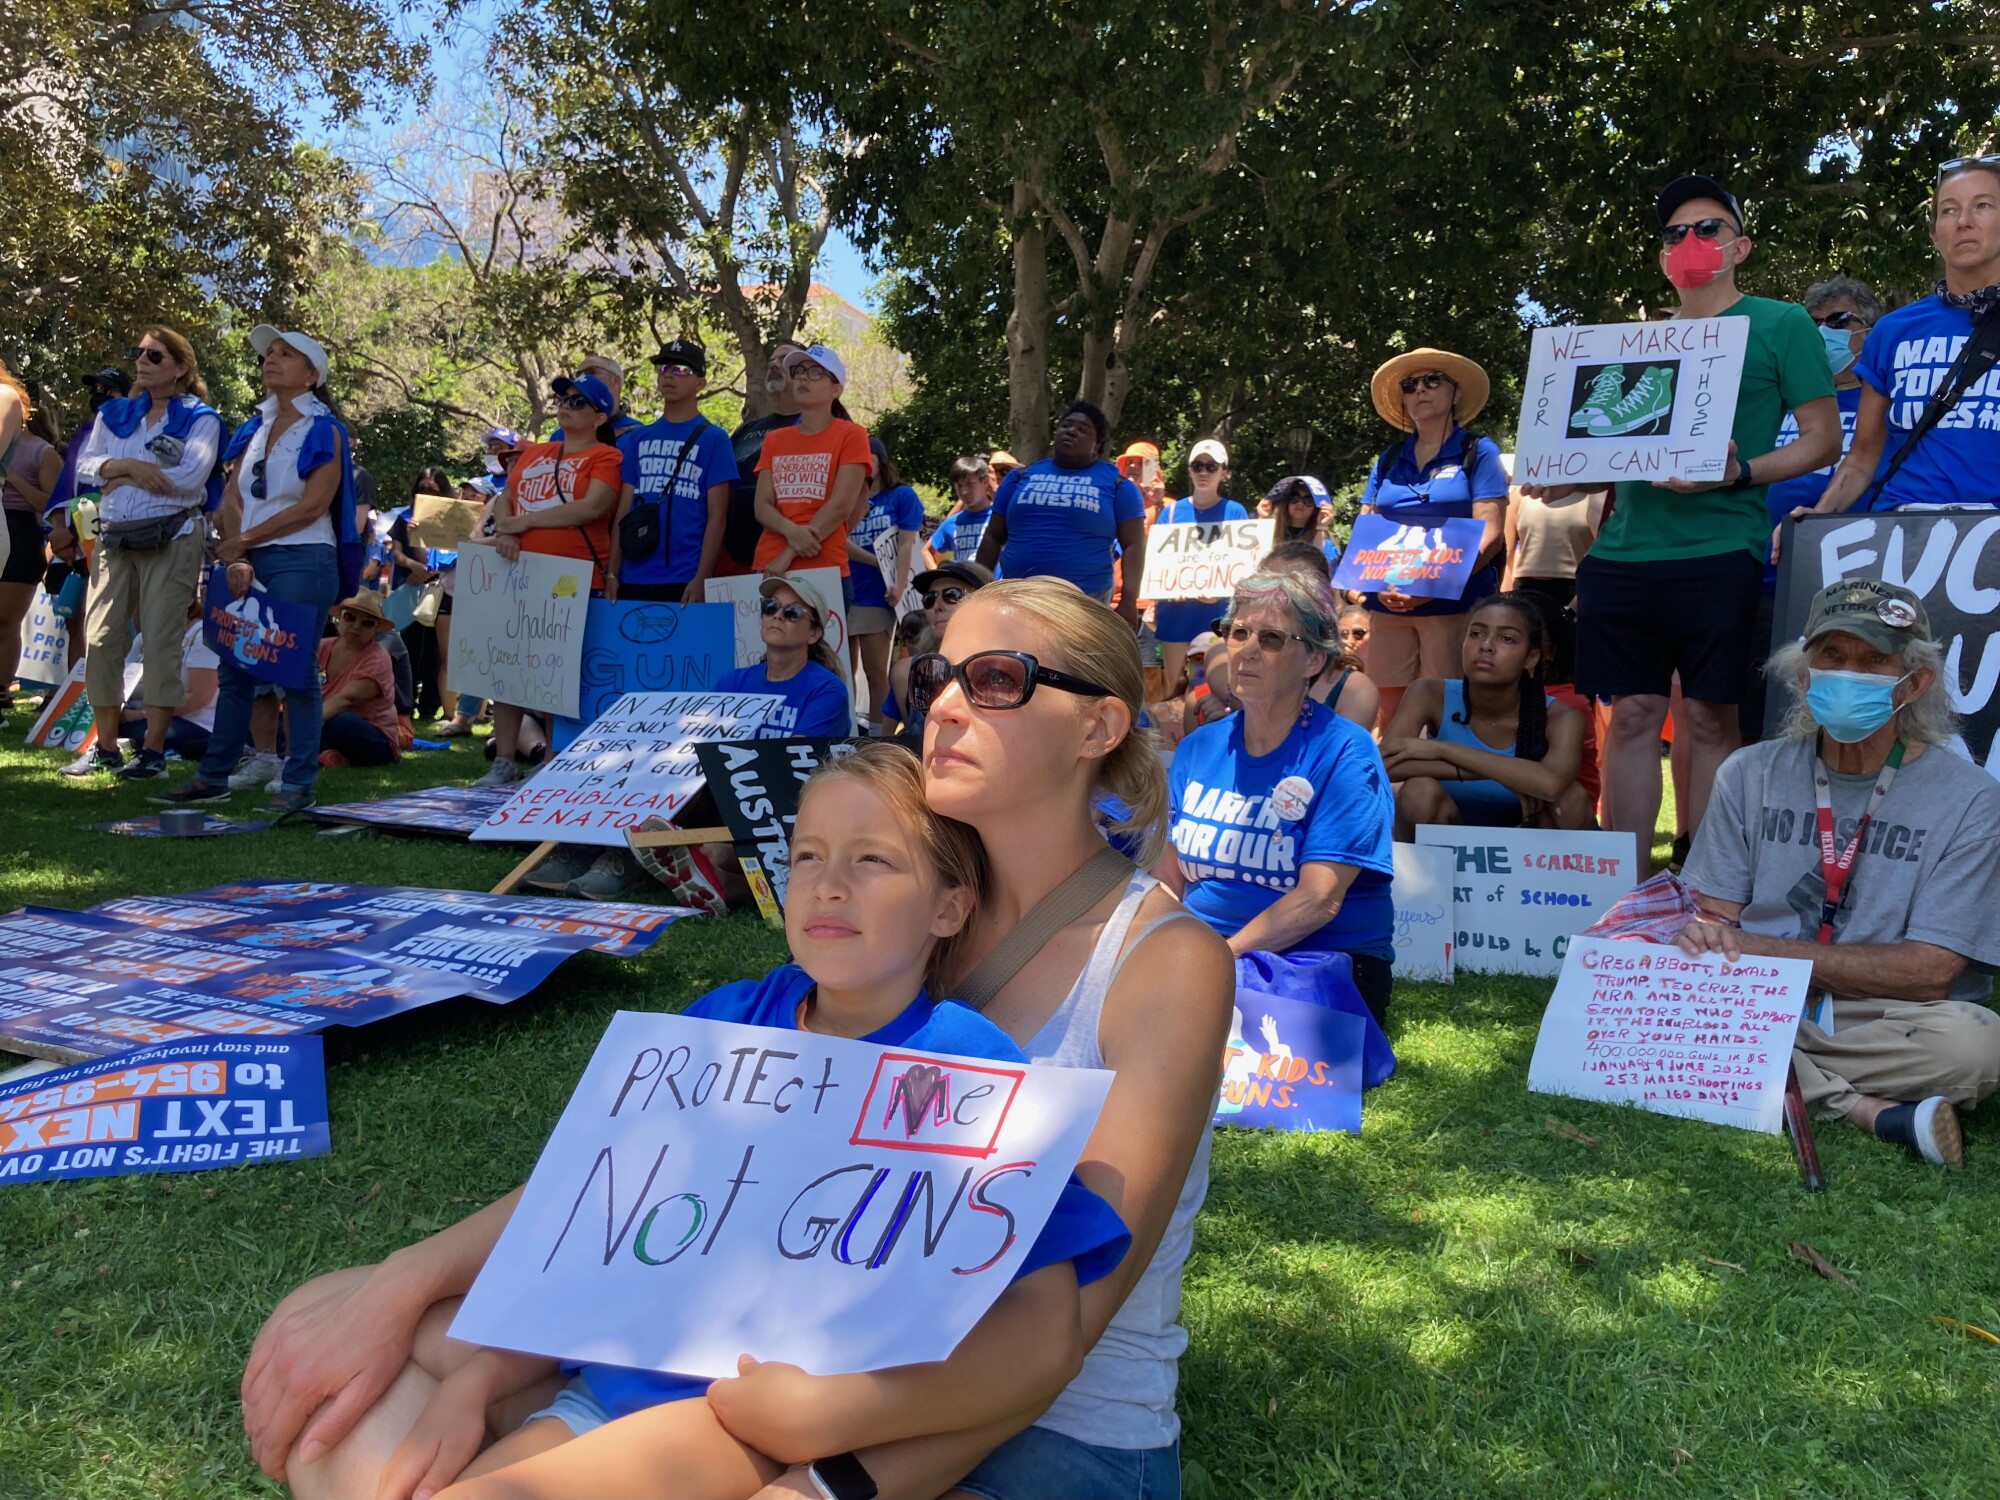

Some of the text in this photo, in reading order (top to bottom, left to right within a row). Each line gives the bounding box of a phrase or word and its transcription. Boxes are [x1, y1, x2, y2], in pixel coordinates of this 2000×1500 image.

[1551, 321, 1721, 362] WE MARCH
[1534, 373, 1557, 427] FOR
[1689, 355, 1727, 437] THOSE
[1525, 446, 1696, 478] WHO CAN'T
[799, 472, 827, 486] WILL
[1029, 473, 1093, 486] MARCH
[805, 487, 825, 497] ALL
[1016, 491, 1073, 508] LIVES
[1022, 481, 1100, 499] FOR OUR
[1156, 522, 1261, 554] ARMS
[1177, 551, 1229, 564] are for
[1352, 548, 1424, 566] PROTECT
[503, 557, 530, 604] Kids
[1358, 565, 1393, 581] NOT
[1825, 581, 1895, 599] MARINES
[1824, 602, 1879, 616] VETERA
[33, 631, 66, 649] PRO
[23, 646, 63, 665] LIFE
[541, 652, 565, 687] go
[607, 696, 649, 716] IN
[655, 695, 780, 720] AMERICA
[588, 720, 620, 735] THE
[627, 720, 677, 735] ONLY
[680, 721, 752, 739] THING
[568, 739, 673, 753] EASIER TO
[548, 758, 705, 777] THAN A GUN
[577, 775, 629, 790] IS A
[510, 788, 687, 811] REPUBLICAN
[1761, 805, 1795, 844] NO
[1214, 828, 1296, 872] OUR
[1820, 830, 1837, 865] MEXICO
[1837, 836, 1859, 870] MEXICO
[1453, 845, 1621, 877] HE SCARIEST
[1453, 884, 1593, 907] RT of SCHOOL
[389, 936, 540, 968] FOR OUR
[1525, 938, 1542, 958] be
[1720, 961, 1780, 977] DONALD
[1659, 976, 1789, 996] TED THE
[94, 995, 204, 1019] TEXT
[1646, 990, 1682, 1002] AND
[1719, 997, 1757, 1007] THE
[269, 1010, 326, 1025] OVER
[1584, 1003, 1682, 1017] SENATORS
[1694, 1007, 1733, 1018] WHO
[1614, 1016, 1653, 1027] THE
[1586, 1028, 1630, 1041] OVER
[1637, 1030, 1686, 1044] YOUR
[128, 1043, 210, 1069] involved
[213, 1041, 252, 1054] stay
[255, 1043, 290, 1055] and
[48, 1068, 80, 1084] the
[82, 1058, 127, 1076] with
[234, 1062, 286, 1090] to
[1603, 1072, 1639, 1085] 253
[1643, 1074, 1684, 1086] MASS
[1219, 1079, 1299, 1109] UNS.
[1698, 1090, 1740, 1106] DAYS
[0, 1099, 306, 1154] TEXT NEX
[245, 1138, 302, 1159] THE
[0, 1154, 44, 1178] OV
[48, 1146, 117, 1171] NOT
[776, 1160, 1038, 1275] GUNS
